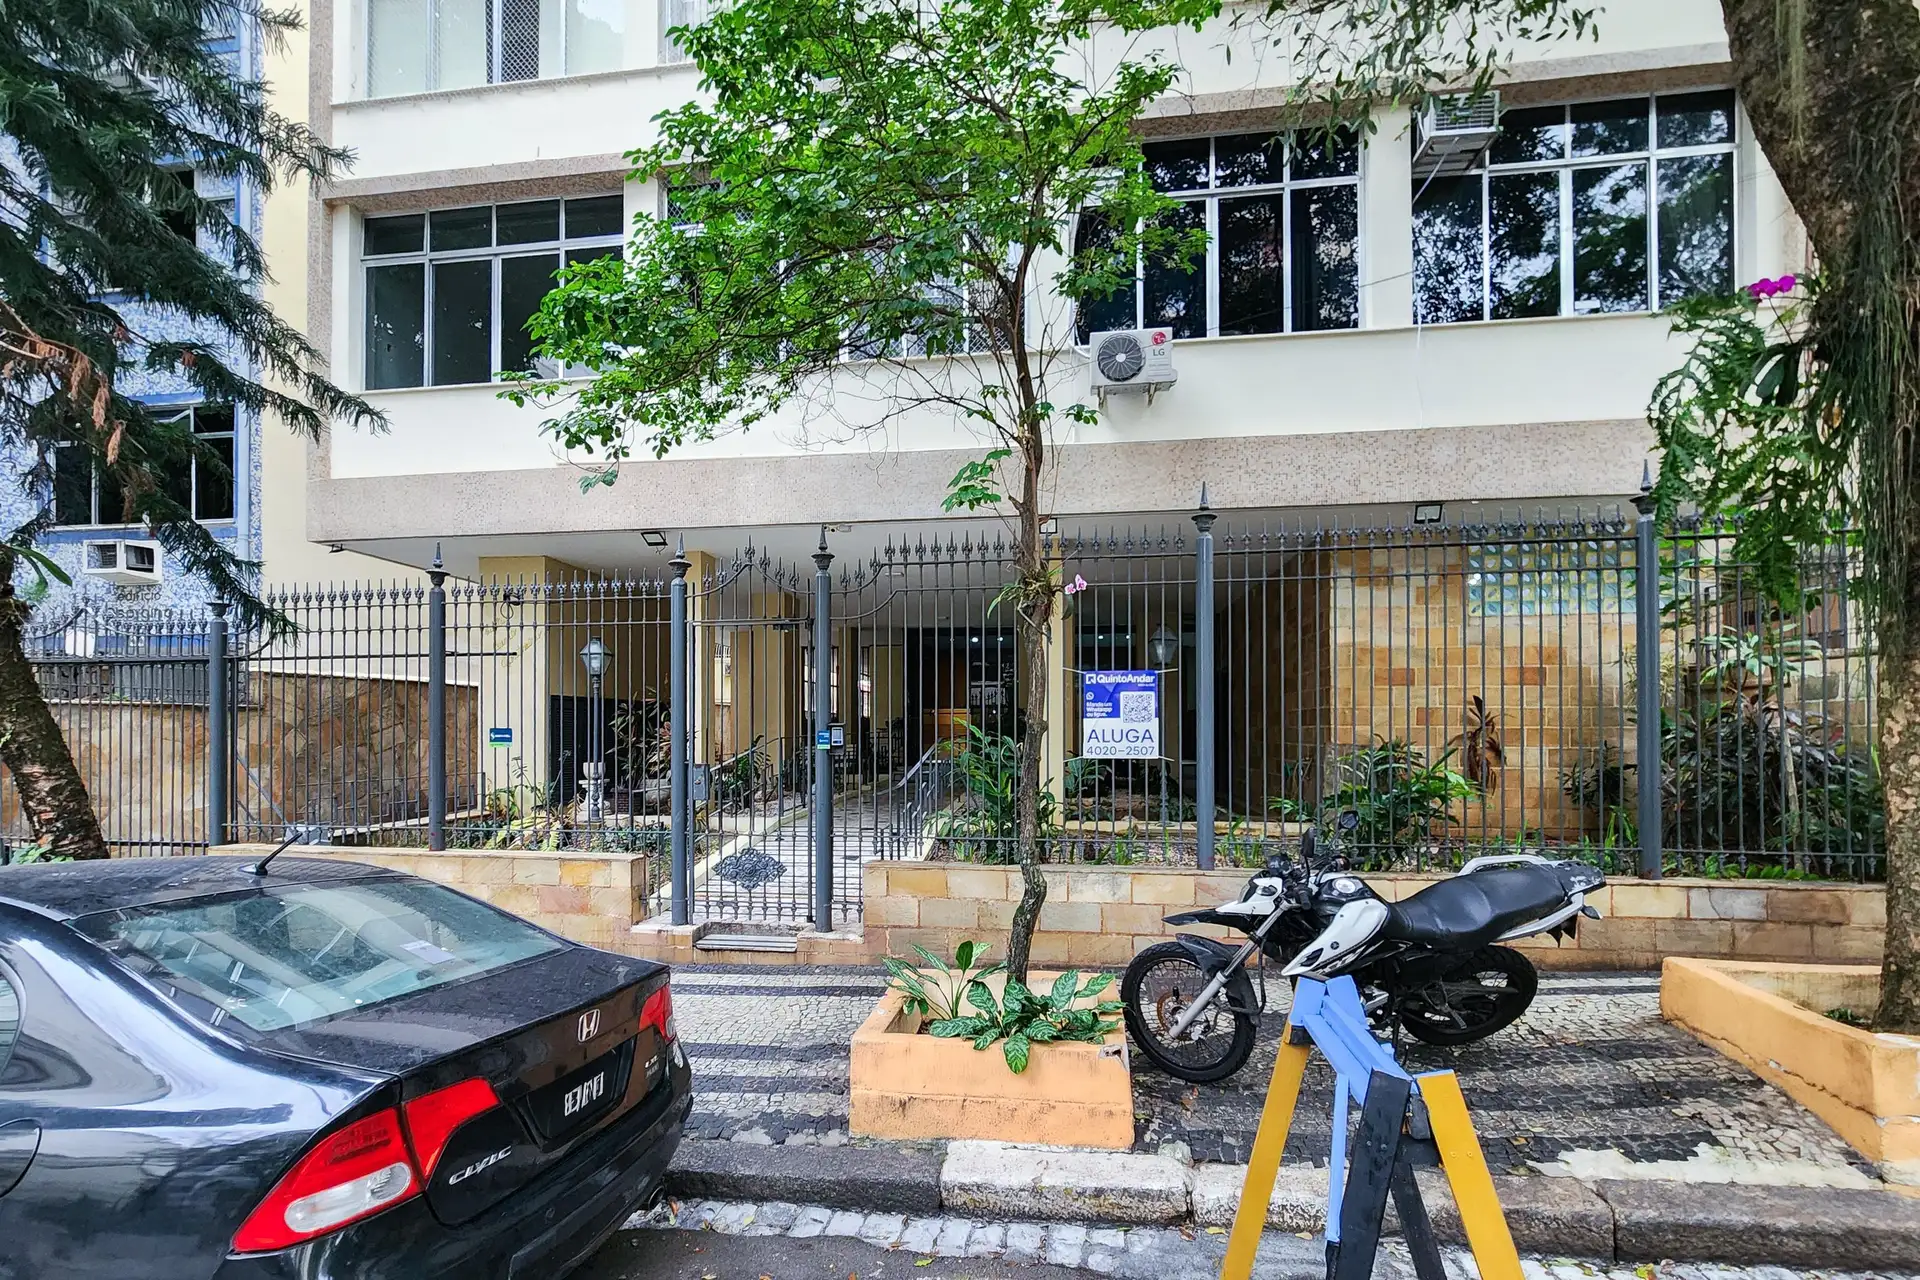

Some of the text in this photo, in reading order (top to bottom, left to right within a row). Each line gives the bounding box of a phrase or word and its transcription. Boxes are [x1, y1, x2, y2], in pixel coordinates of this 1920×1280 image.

[1152, 348, 1165, 356] LG
[1097, 674, 1155, 684] QuintoAndar
[1087, 728, 1155, 743] ALUGA
[1086, 746, 1155, 756] 4020-2507
